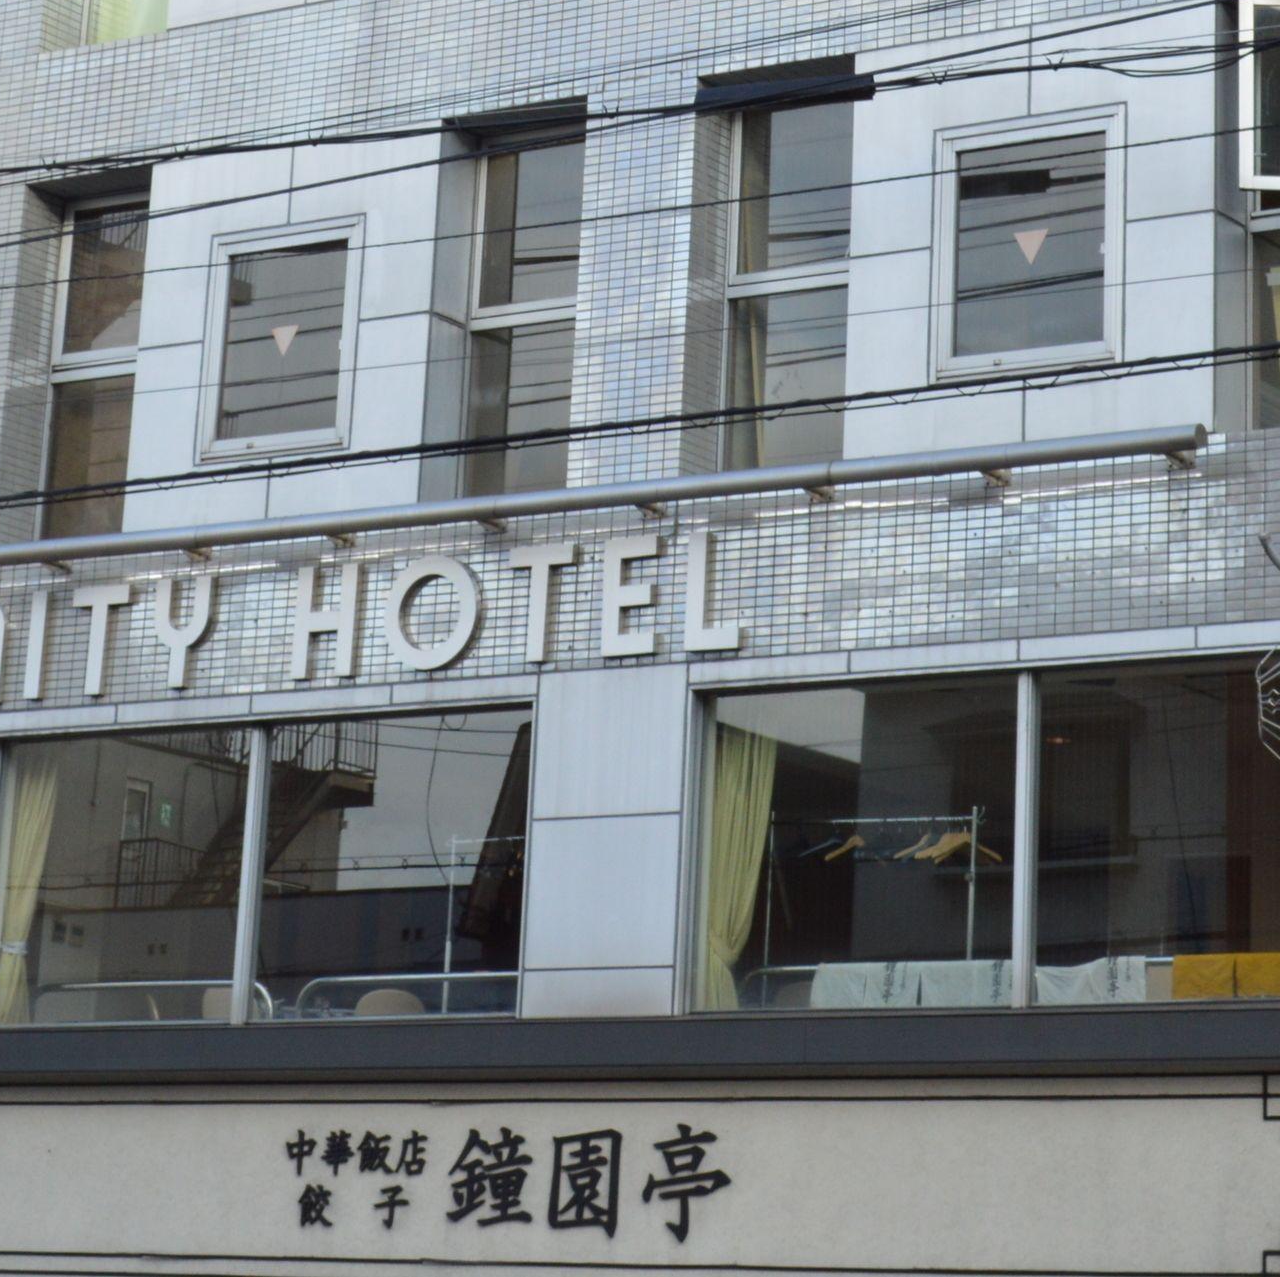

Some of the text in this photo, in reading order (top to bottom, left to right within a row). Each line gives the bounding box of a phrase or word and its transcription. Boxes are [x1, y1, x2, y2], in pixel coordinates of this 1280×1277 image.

[290, 533, 744, 680] HOTEL
[284, 1129, 428, 1176] 中華飯店
[447, 1123, 731, 1243] 鐘園亭
